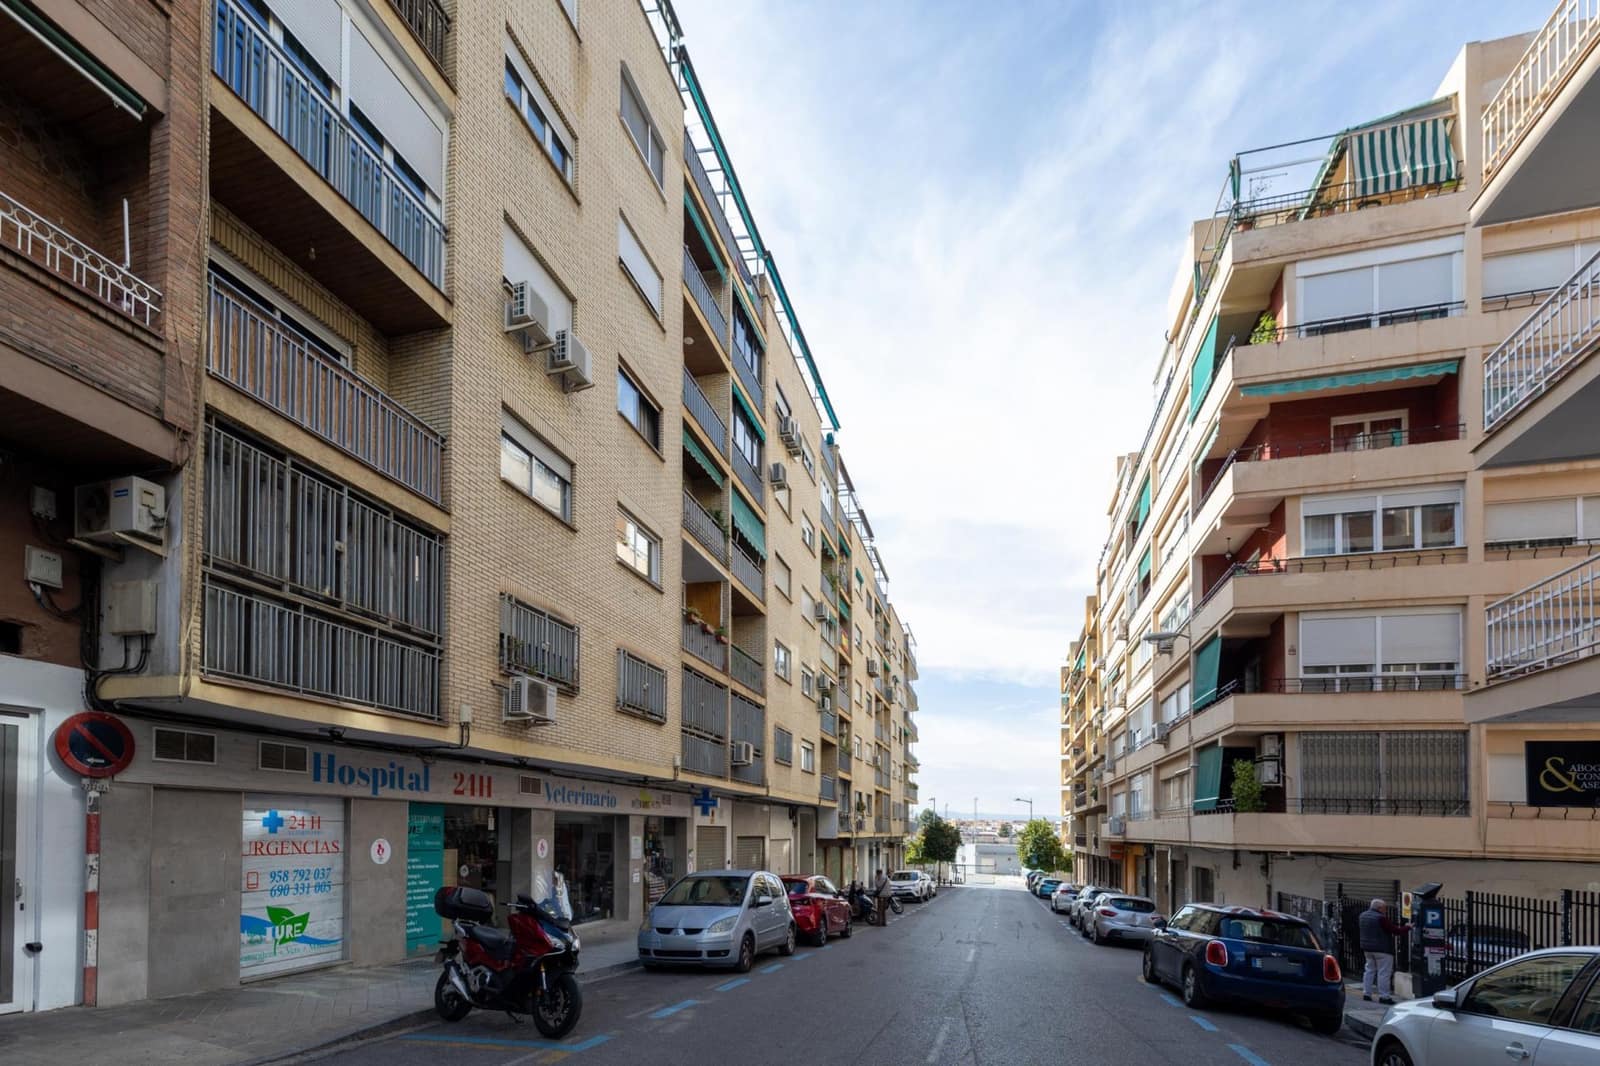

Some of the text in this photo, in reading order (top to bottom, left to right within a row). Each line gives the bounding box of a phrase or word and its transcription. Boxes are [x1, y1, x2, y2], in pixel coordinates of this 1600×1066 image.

[313, 752, 430, 796] Hospital
[545, 782, 617, 808] Veterinario
[288, 815, 321, 830] 24 H
[270, 867, 332, 883] 958 792 037
[270, 883, 290, 897] 690
[1426, 911, 1440, 925] P
